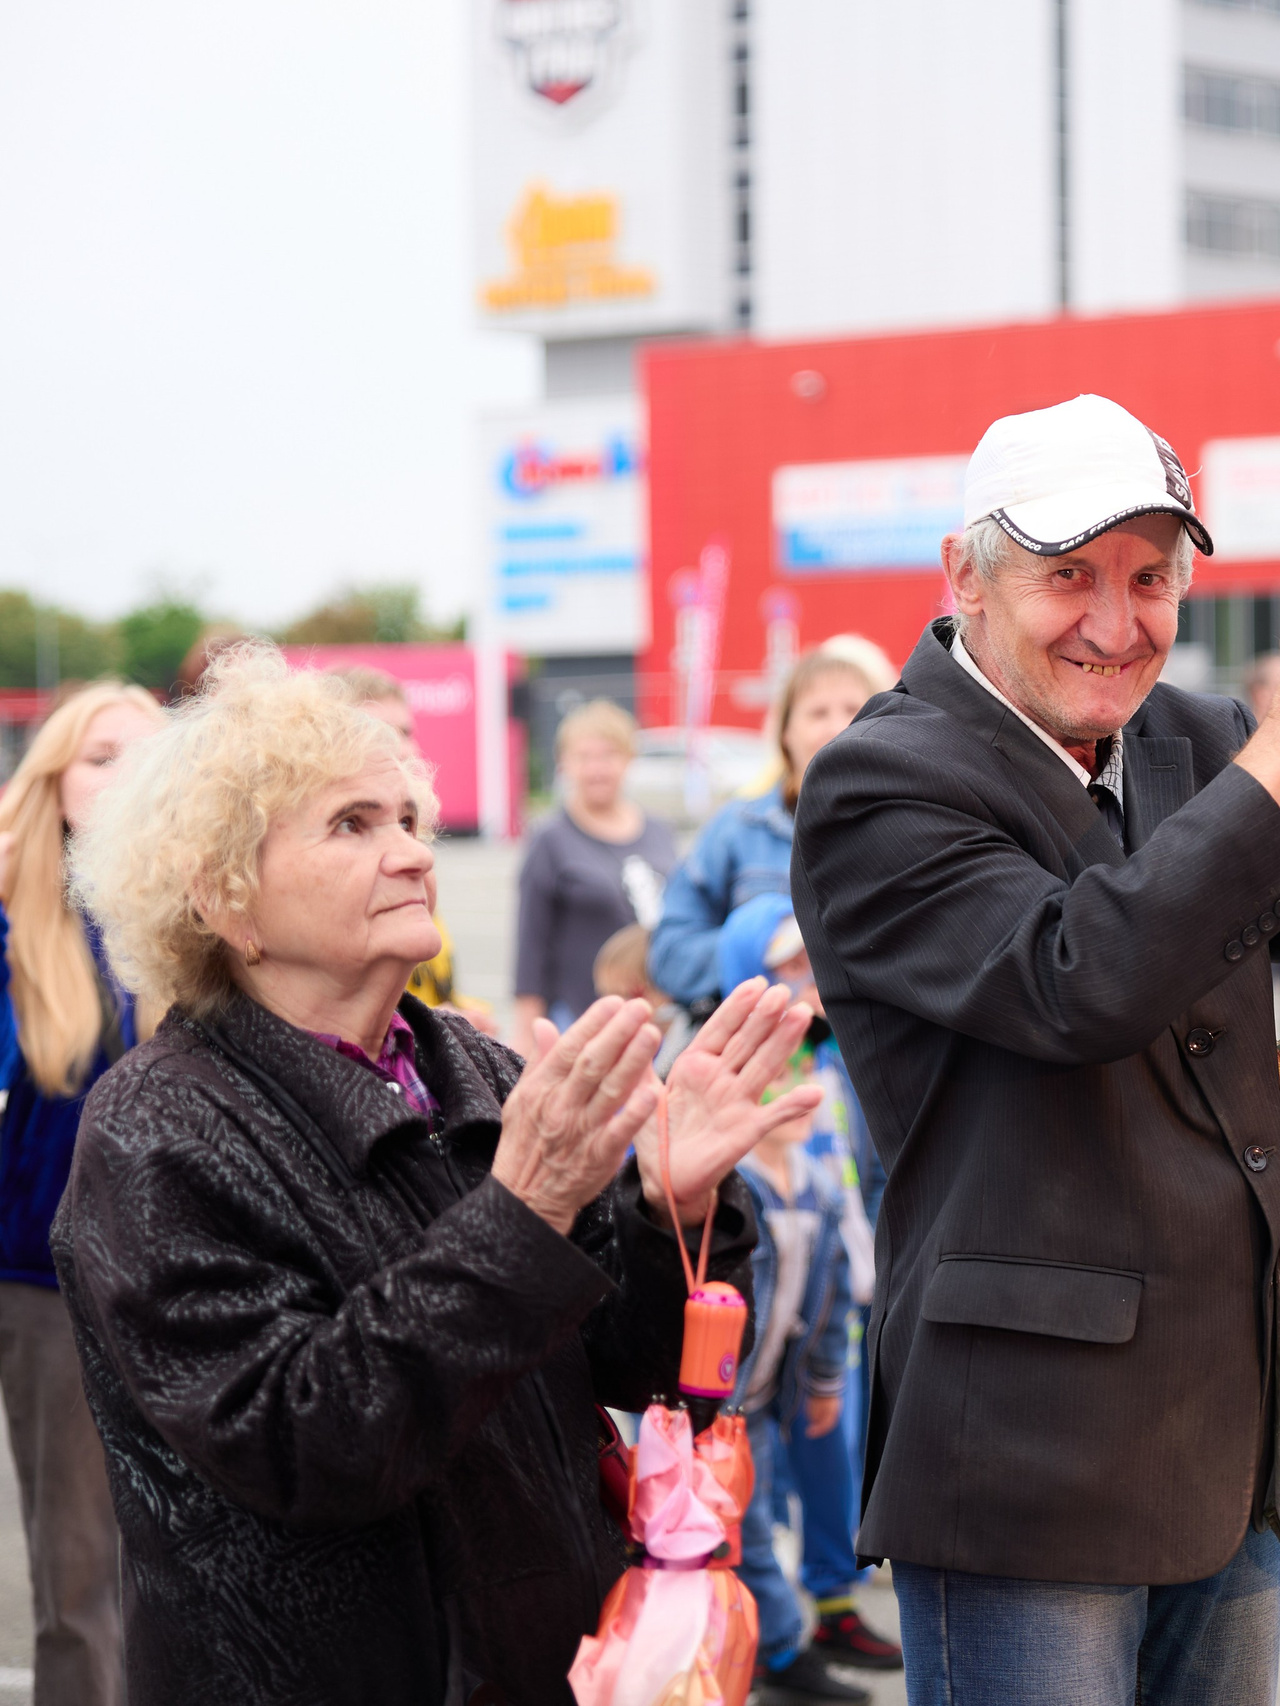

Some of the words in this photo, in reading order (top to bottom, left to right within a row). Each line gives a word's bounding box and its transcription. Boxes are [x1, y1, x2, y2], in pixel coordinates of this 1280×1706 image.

[999, 518, 1042, 552] FRANCISCO
[1059, 534, 1085, 551] SAN
[1089, 503, 1173, 535] FRANCISCO
